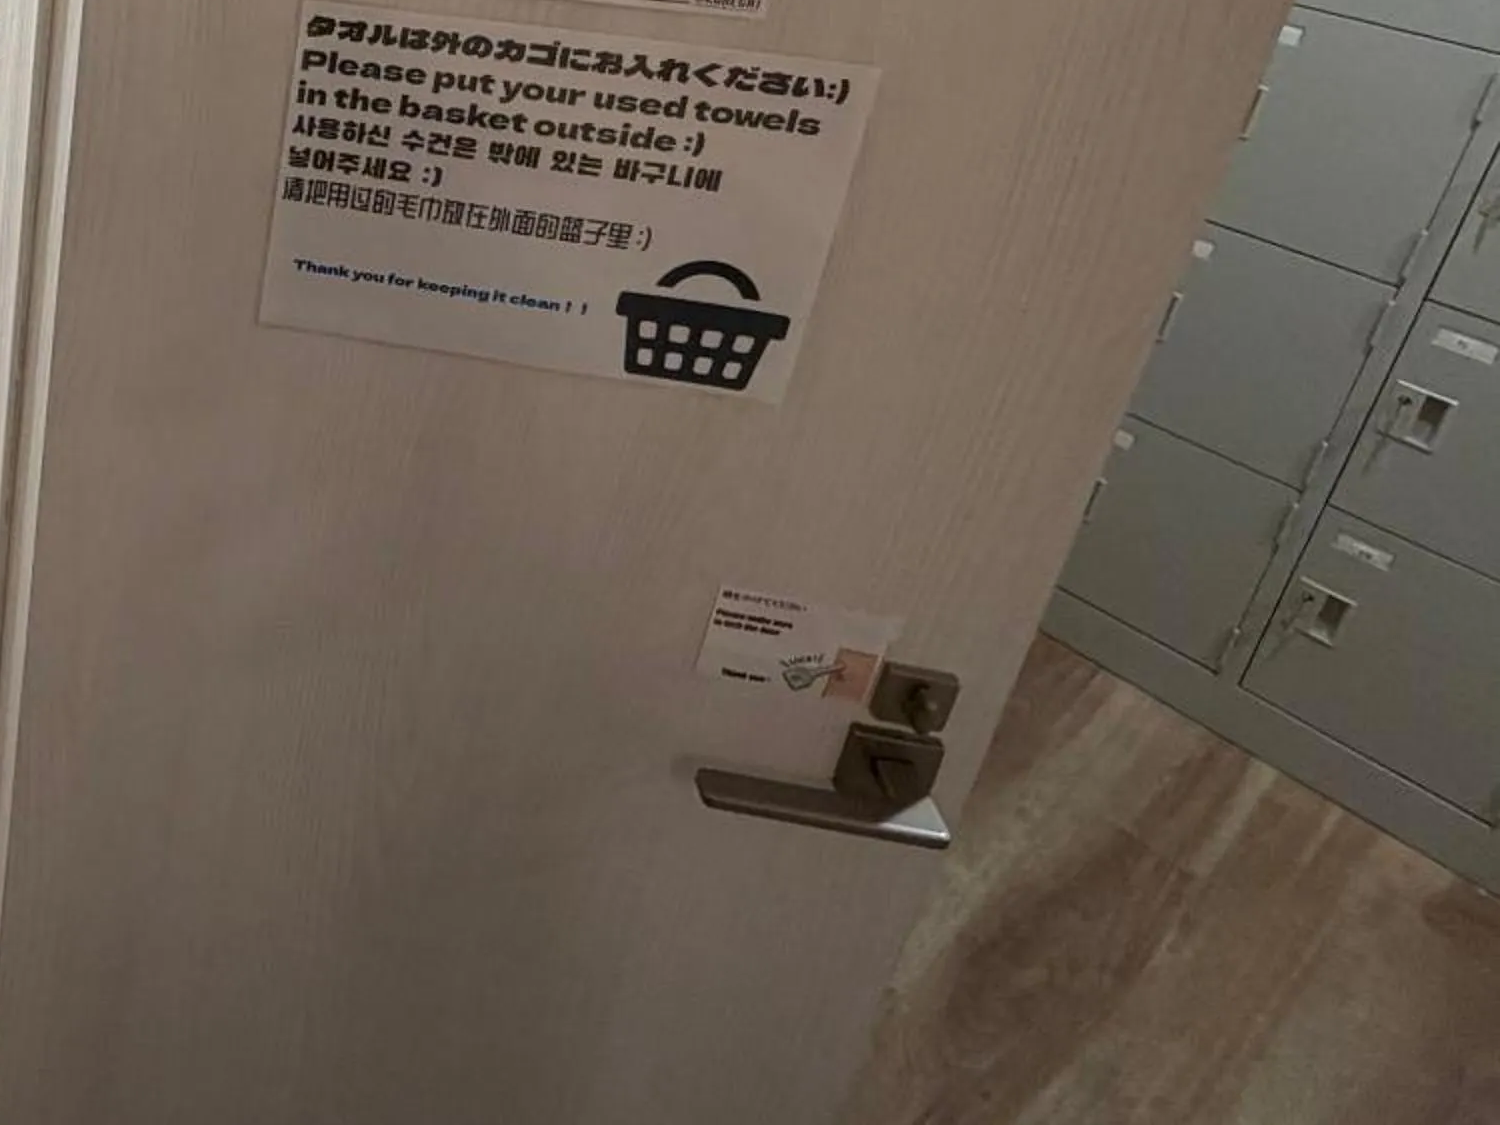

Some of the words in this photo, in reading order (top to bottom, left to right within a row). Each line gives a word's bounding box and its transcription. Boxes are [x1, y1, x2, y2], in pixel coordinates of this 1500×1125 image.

[296, 79, 327, 106] in
[333, 85, 393, 115] the
[398, 94, 530, 135] basket
[533, 118, 677, 153] outside
[301, 48, 427, 86] Please
[431, 70, 497, 94] put
[499, 79, 587, 106] your
[593, 91, 689, 120] used
[694, 100, 821, 136] towels
[292, 114, 391, 148] 사용하신
[401, 129, 478, 160] 수건은
[488, 140, 542, 170] 밖에
[550, 149, 603, 177] 있는
[612, 157, 724, 193] 바구니에
[293, 258, 350, 278] Thank
[352, 270, 384, 282] you
[386, 273, 415, 289] for
[417, 278, 490, 303] keeping
[492, 287, 507, 303] it
